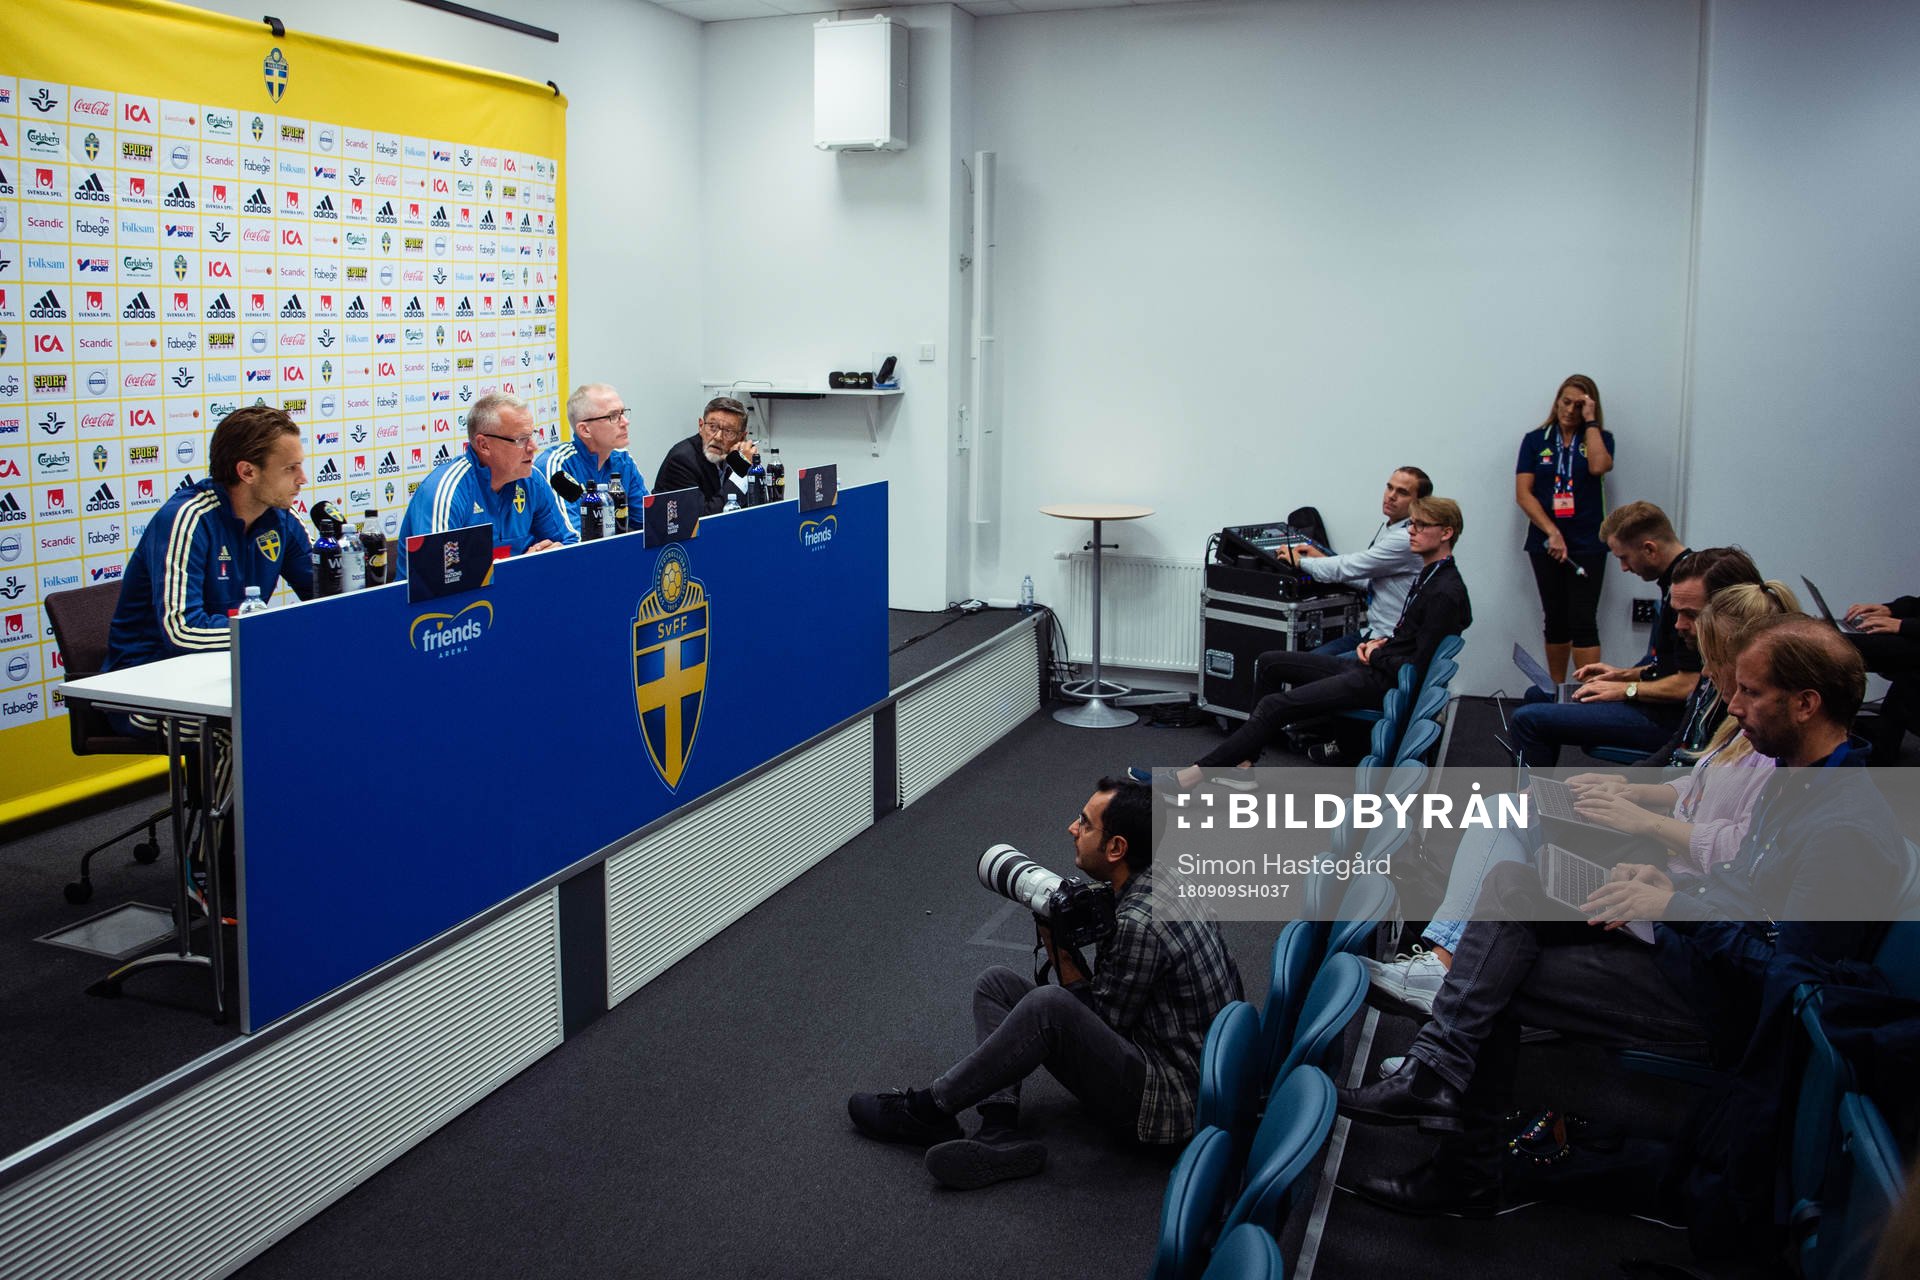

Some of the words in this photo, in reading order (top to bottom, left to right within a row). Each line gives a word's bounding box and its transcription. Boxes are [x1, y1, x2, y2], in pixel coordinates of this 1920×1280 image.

[39, 89, 49, 100] SJ
[126, 104, 151, 123] ICA
[28, 130, 59, 145] Carlsberg
[281, 126, 305, 139] SPORT
[123, 143, 152, 157] SPORT
[346, 139, 368, 149] Scandic
[206, 156, 234, 166] Scandic
[244, 160, 270, 174] Fabege
[504, 159, 516, 172] ICA
[433, 179, 448, 193] ICA
[75, 191, 109, 201] adidas
[164, 199, 195, 208] adidas
[244, 204, 271, 213] adidas
[313, 211, 338, 219] adidas
[376, 216, 397, 224] adidas
[28, 217, 63, 228] Scandic
[77, 220, 109, 236] Fabege
[122, 222, 154, 233] Folksam
[217, 222, 224, 232] SJ
[283, 230, 302, 245] ICA
[28, 258, 64, 269] Folksam
[124, 257, 152, 271] Carlsberg
[209, 261, 232, 277] ICA
[281, 268, 305, 276] Scandic
[314, 268, 337, 281] Fabege
[30, 308, 66, 318] adidas
[123, 309, 155, 318] adidas
[207, 310, 235, 318] adidas
[281, 310, 306, 318] adidas
[208, 334, 235, 344] SPORT
[458, 330, 472, 342] ICA
[34, 335, 64, 352] ICA
[80, 339, 112, 347] Scandic
[168, 338, 196, 350] Fabege
[179, 368, 187, 377] SJ
[284, 366, 304, 381] ICA
[379, 363, 395, 376] ICA
[34, 375, 66, 388] SPORT
[208, 373, 236, 382] Folksam
[0, 384, 18, 396] ege
[503, 383, 514, 394] ICA
[284, 400, 306, 411] SPORT
[48, 412, 56, 422] SJ
[130, 410, 156, 426] ICA
[434, 419, 449, 432] ICA
[130, 447, 158, 459] SPORT
[38, 454, 70, 467] Carlsberg
[0, 460, 21, 477] CA
[317, 473, 341, 482] adidas
[86, 500, 120, 512] adidas
[41, 536, 76, 548] Scandic
[89, 533, 120, 544] Fabege
[805, 527, 832, 546] friends
[7, 576, 16, 586] SJ
[43, 575, 78, 587] Folksam
[658, 616, 688, 638] SvFF
[423, 619, 481, 652] friends
[439, 646, 468, 658] ARENA
[3, 701, 38, 715] Fabege
